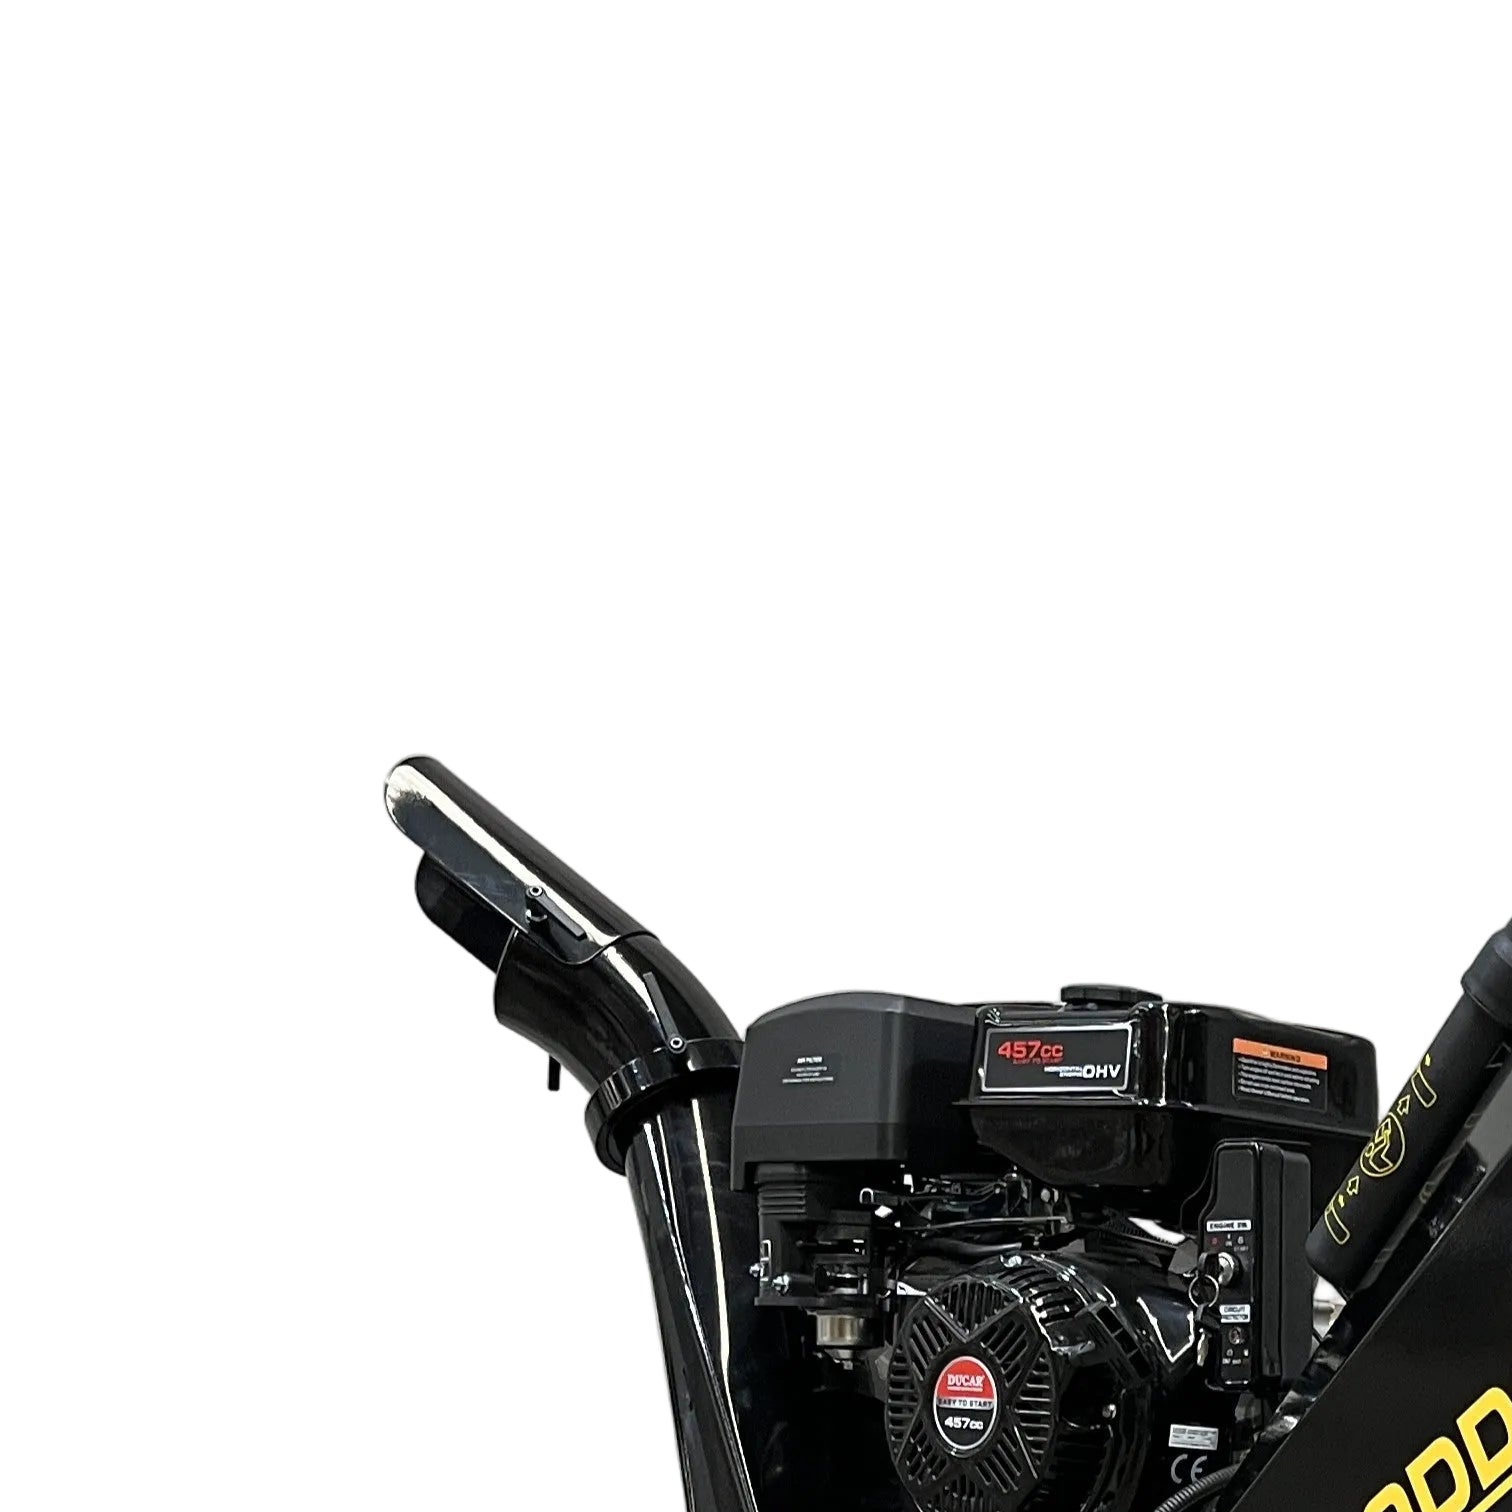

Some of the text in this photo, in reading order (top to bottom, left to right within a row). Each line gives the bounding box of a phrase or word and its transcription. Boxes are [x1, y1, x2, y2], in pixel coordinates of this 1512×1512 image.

[998, 1039, 1064, 1059] 457cc
[1082, 1064, 1121, 1078] OHV
[944, 1416, 984, 1430] 457cc
